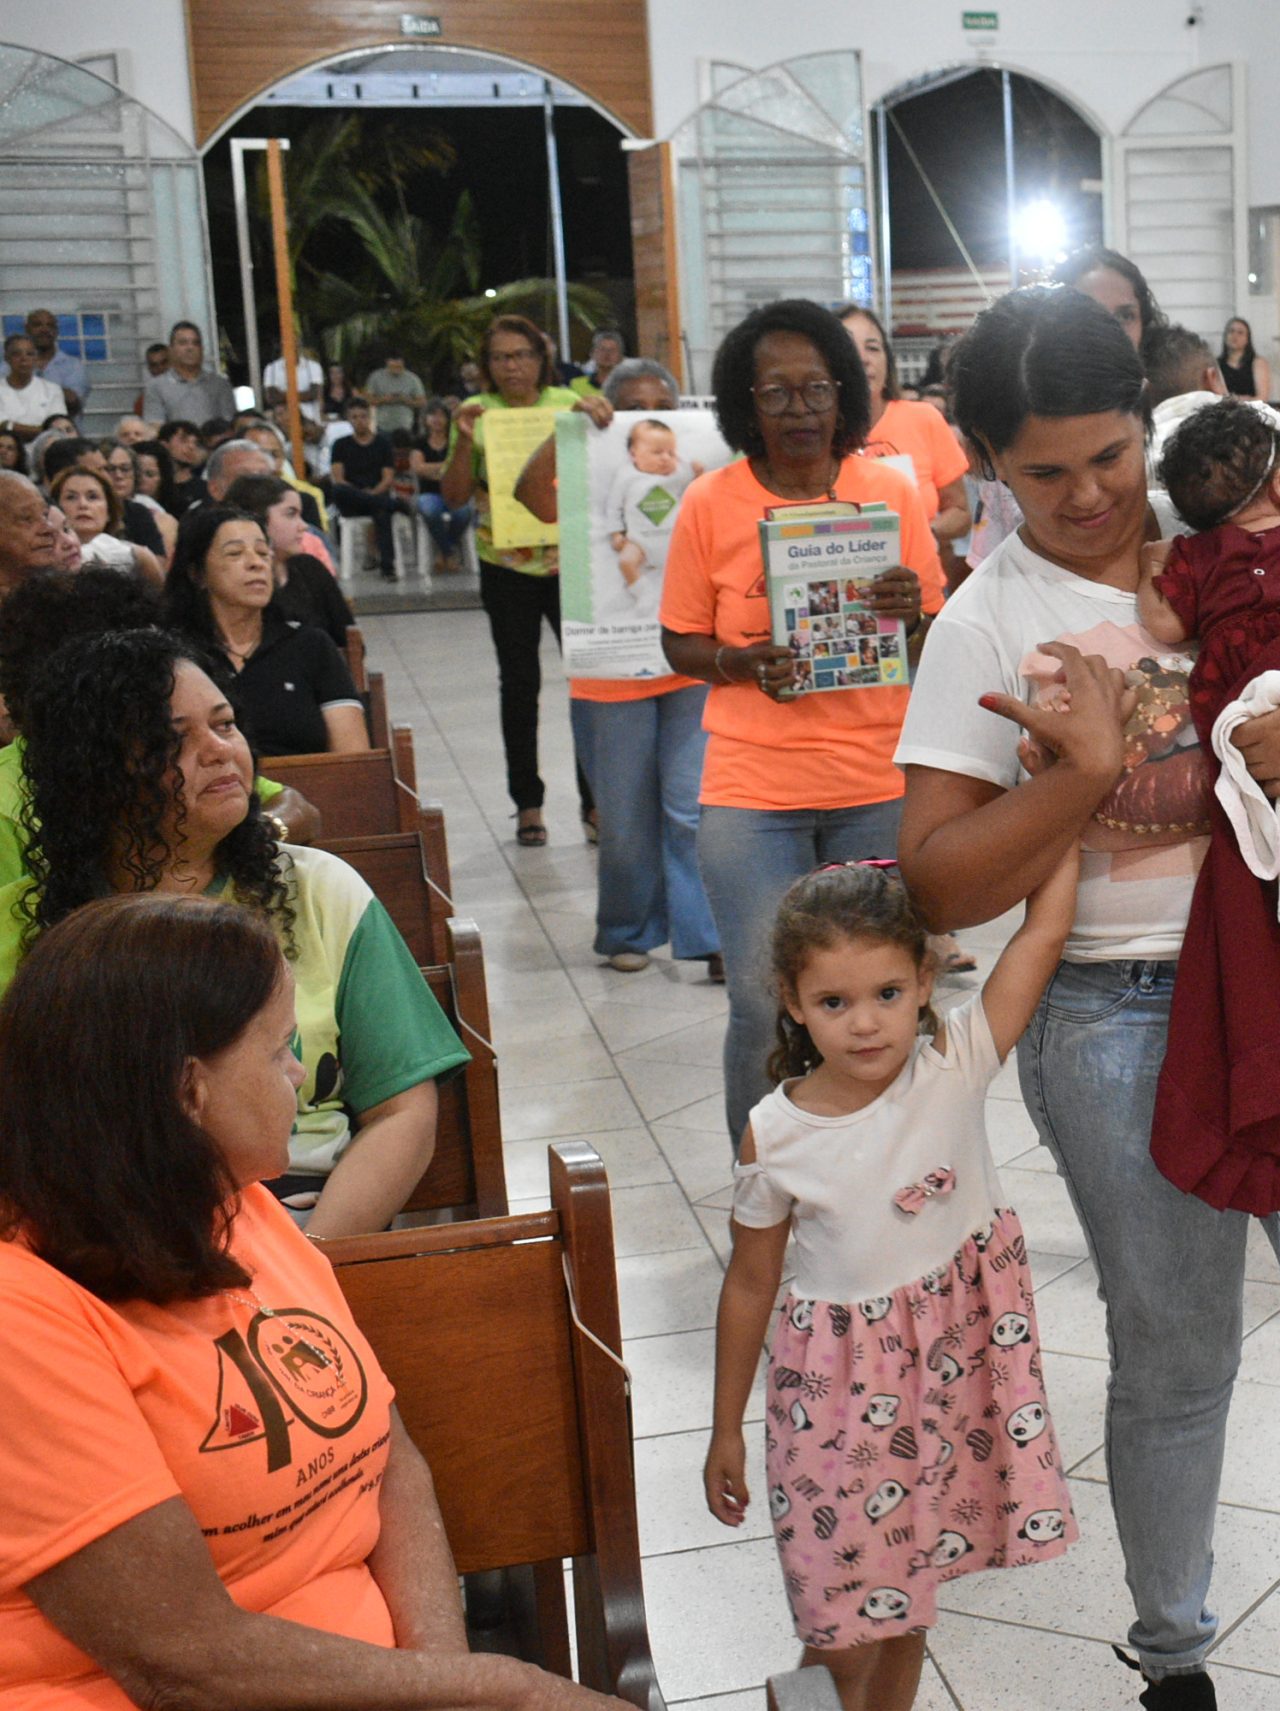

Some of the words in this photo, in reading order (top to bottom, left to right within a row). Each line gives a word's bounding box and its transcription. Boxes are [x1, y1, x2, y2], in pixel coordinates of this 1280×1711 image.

[788, 543, 822, 558] Guia
[826, 542, 844, 555] do
[848, 539, 887, 553] Líder
[801, 558, 838, 569] Pastoral
[840, 556, 852, 566] da
[854, 554, 888, 566] Criança
[296, 1446, 335, 1488] ANOS
[223, 1512, 272, 1535] acolher
[275, 1506, 292, 1520] em
[262, 1525, 288, 1543] mim
